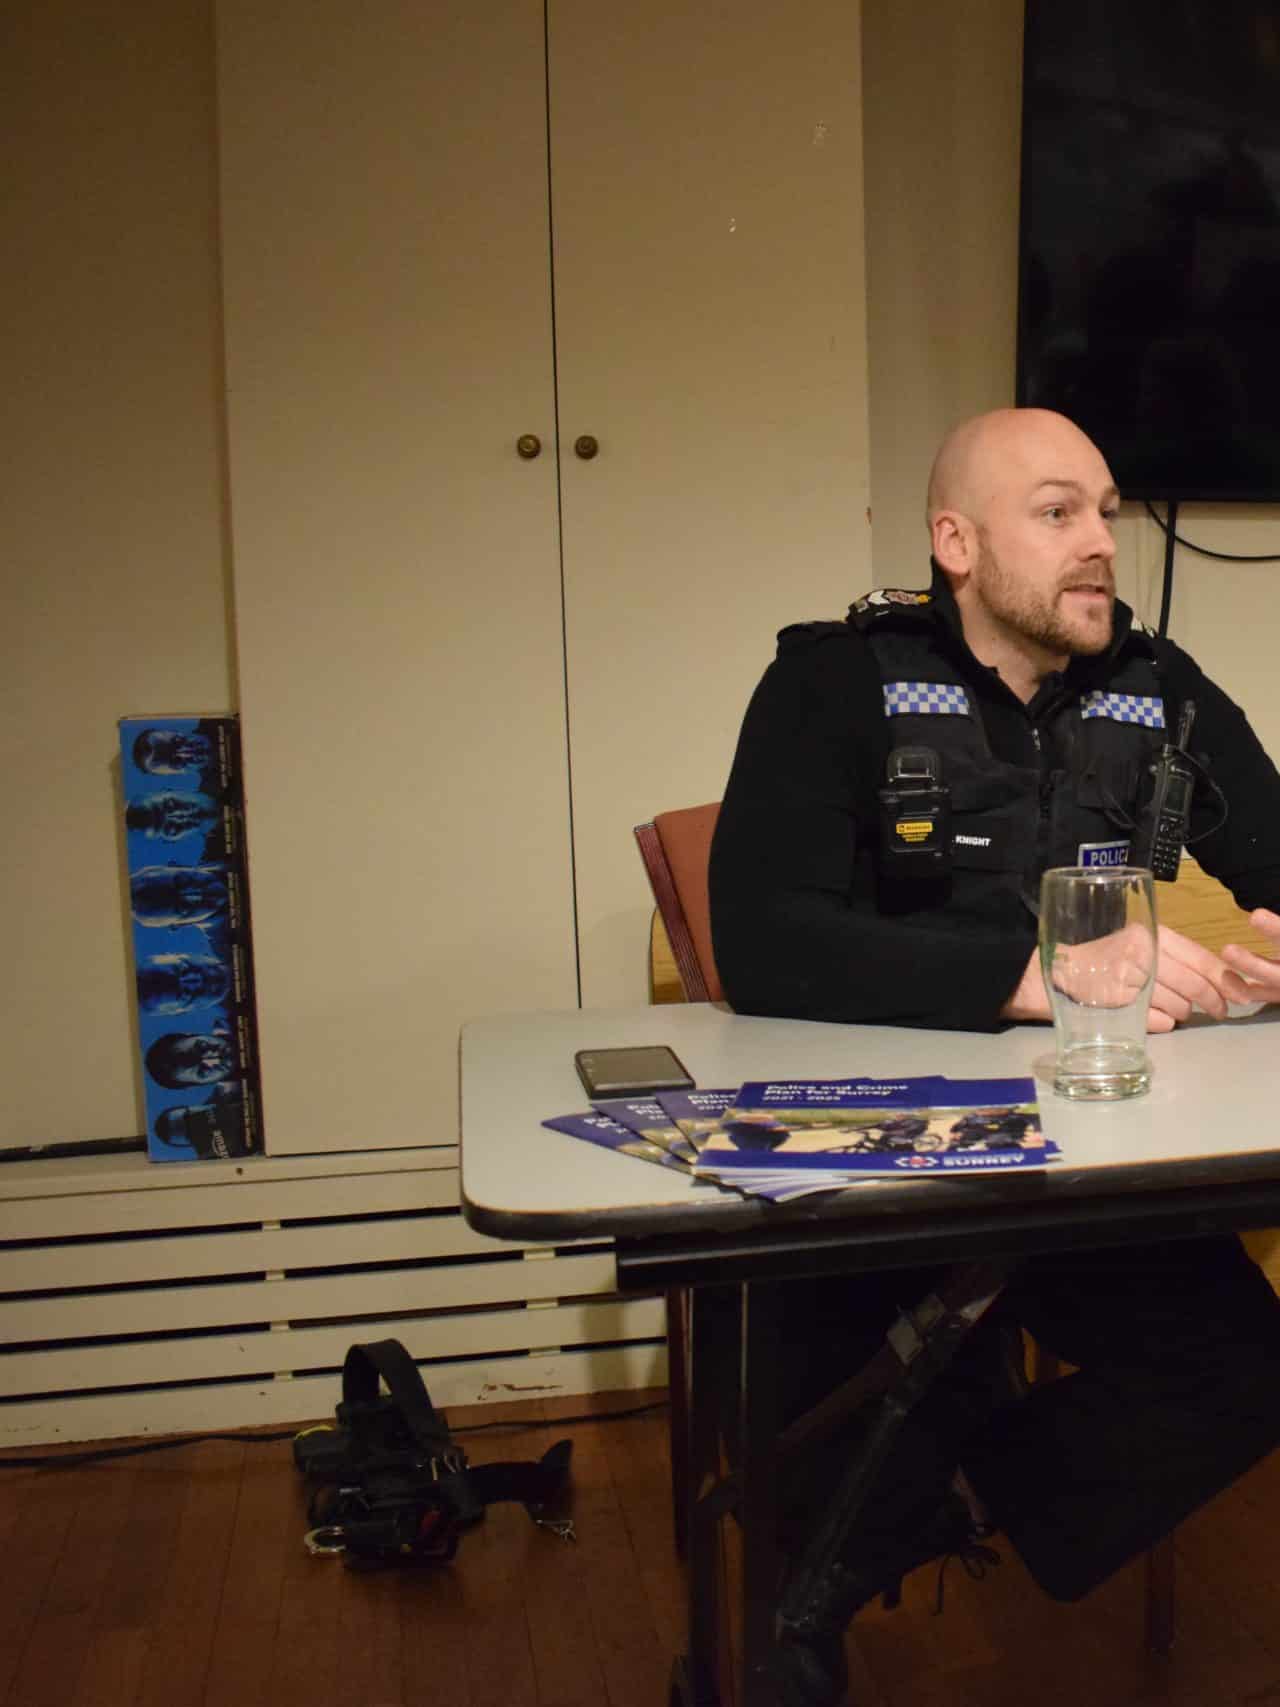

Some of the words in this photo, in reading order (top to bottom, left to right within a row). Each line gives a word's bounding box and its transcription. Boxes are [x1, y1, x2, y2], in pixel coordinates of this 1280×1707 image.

[955, 835, 992, 848] KNIGHT
[1090, 847, 1128, 866] POLIC
[943, 1153, 1025, 1167] SURREY
